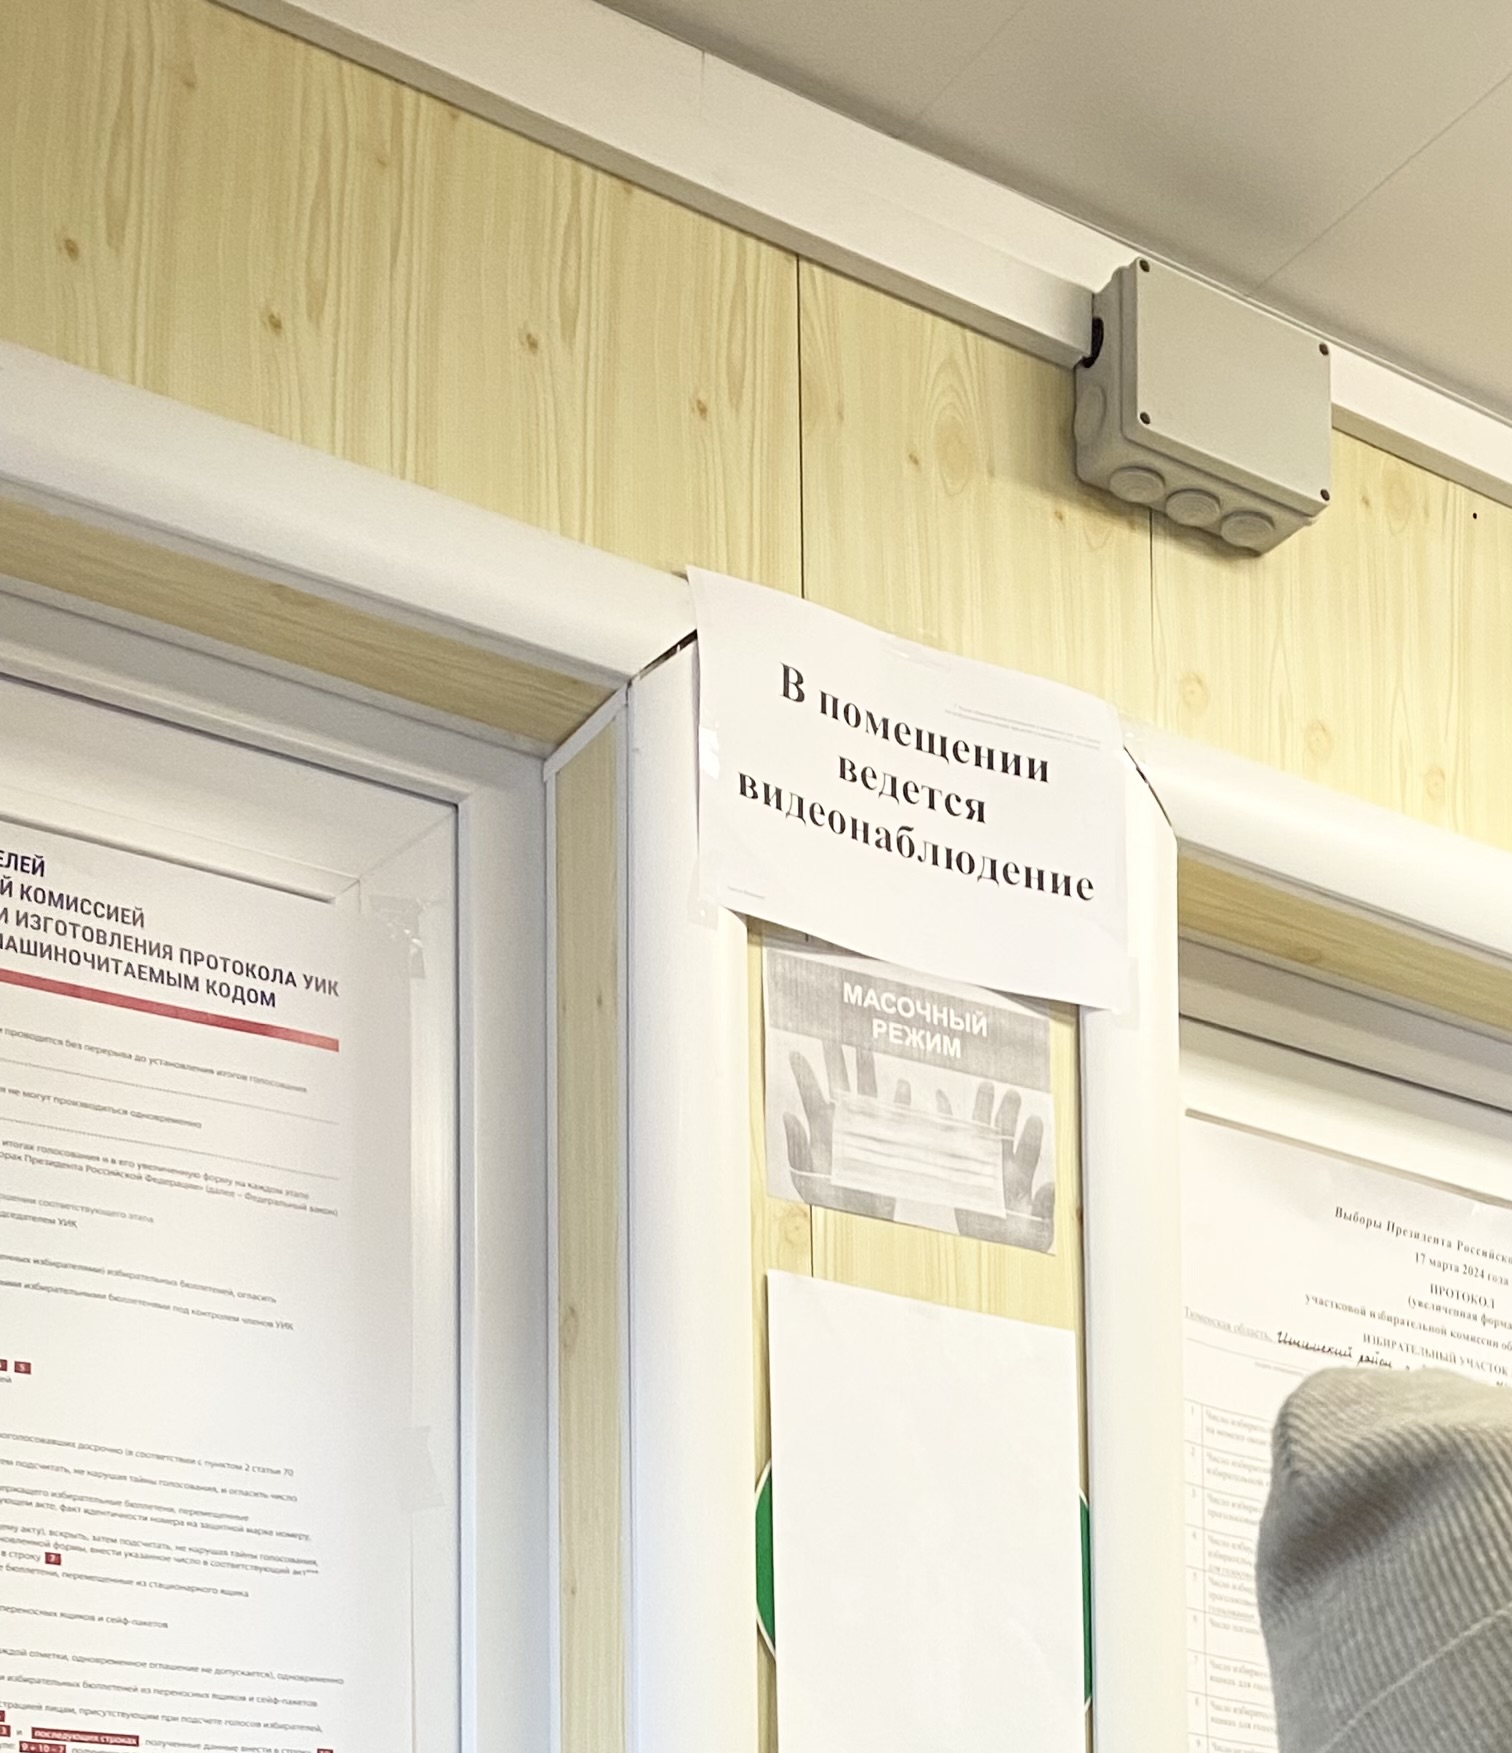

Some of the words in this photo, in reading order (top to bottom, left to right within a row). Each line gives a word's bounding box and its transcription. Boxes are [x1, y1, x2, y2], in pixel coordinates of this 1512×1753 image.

[779, 662, 805, 702] В
[819, 690, 1049, 783] помещении
[838, 755, 986, 824] ведется
[738, 772, 1094, 900] видеонаблюдение
[21, 884, 144, 928] КОМИССИЕЙ
[16, 910, 172, 961] ИЗГОТОВЛЕНИЯ
[180, 948, 297, 987] ПРОТОКОЛА
[303, 974, 339, 997] УИК
[206, 979, 276, 1008] КОДОМ
[844, 982, 987, 1037] МАСОЧНЫЙ
[66, 1040, 82, 1050] без
[134, 1054, 146, 1062] до
[873, 1018, 960, 1058] РЕЖИМ
[23, 1091, 50, 1102] могут
[37, 1145, 100, 1162] голосования
[1335, 1206, 1382, 1229] Выборы
[1387, 1220, 1452, 1249] Президента
[1415, 1252, 1426, 1263] 17
[1430, 1257, 1459, 1273] марта
[1463, 1264, 1485, 1280] 2024
[1487, 1272, 1509, 1286] года
[1408, 1296, 1478, 1322] (увеличенная
[1430, 1283, 1495, 1309] ПРОТОКОЛ
[1305, 1294, 1366, 1316] участковой
[1370, 1309, 1447, 1336] избирательной
[1450, 1330, 1499, 1349] комиссии
[1501, 1341, 1512, 1352] об
[1363, 1333, 1456, 1364] ИЗБИРАТЕЛЬНЫЙ
[1460, 1356, 1508, 1376] УЧАСТОК
[283, 1468, 294, 1477] 70
